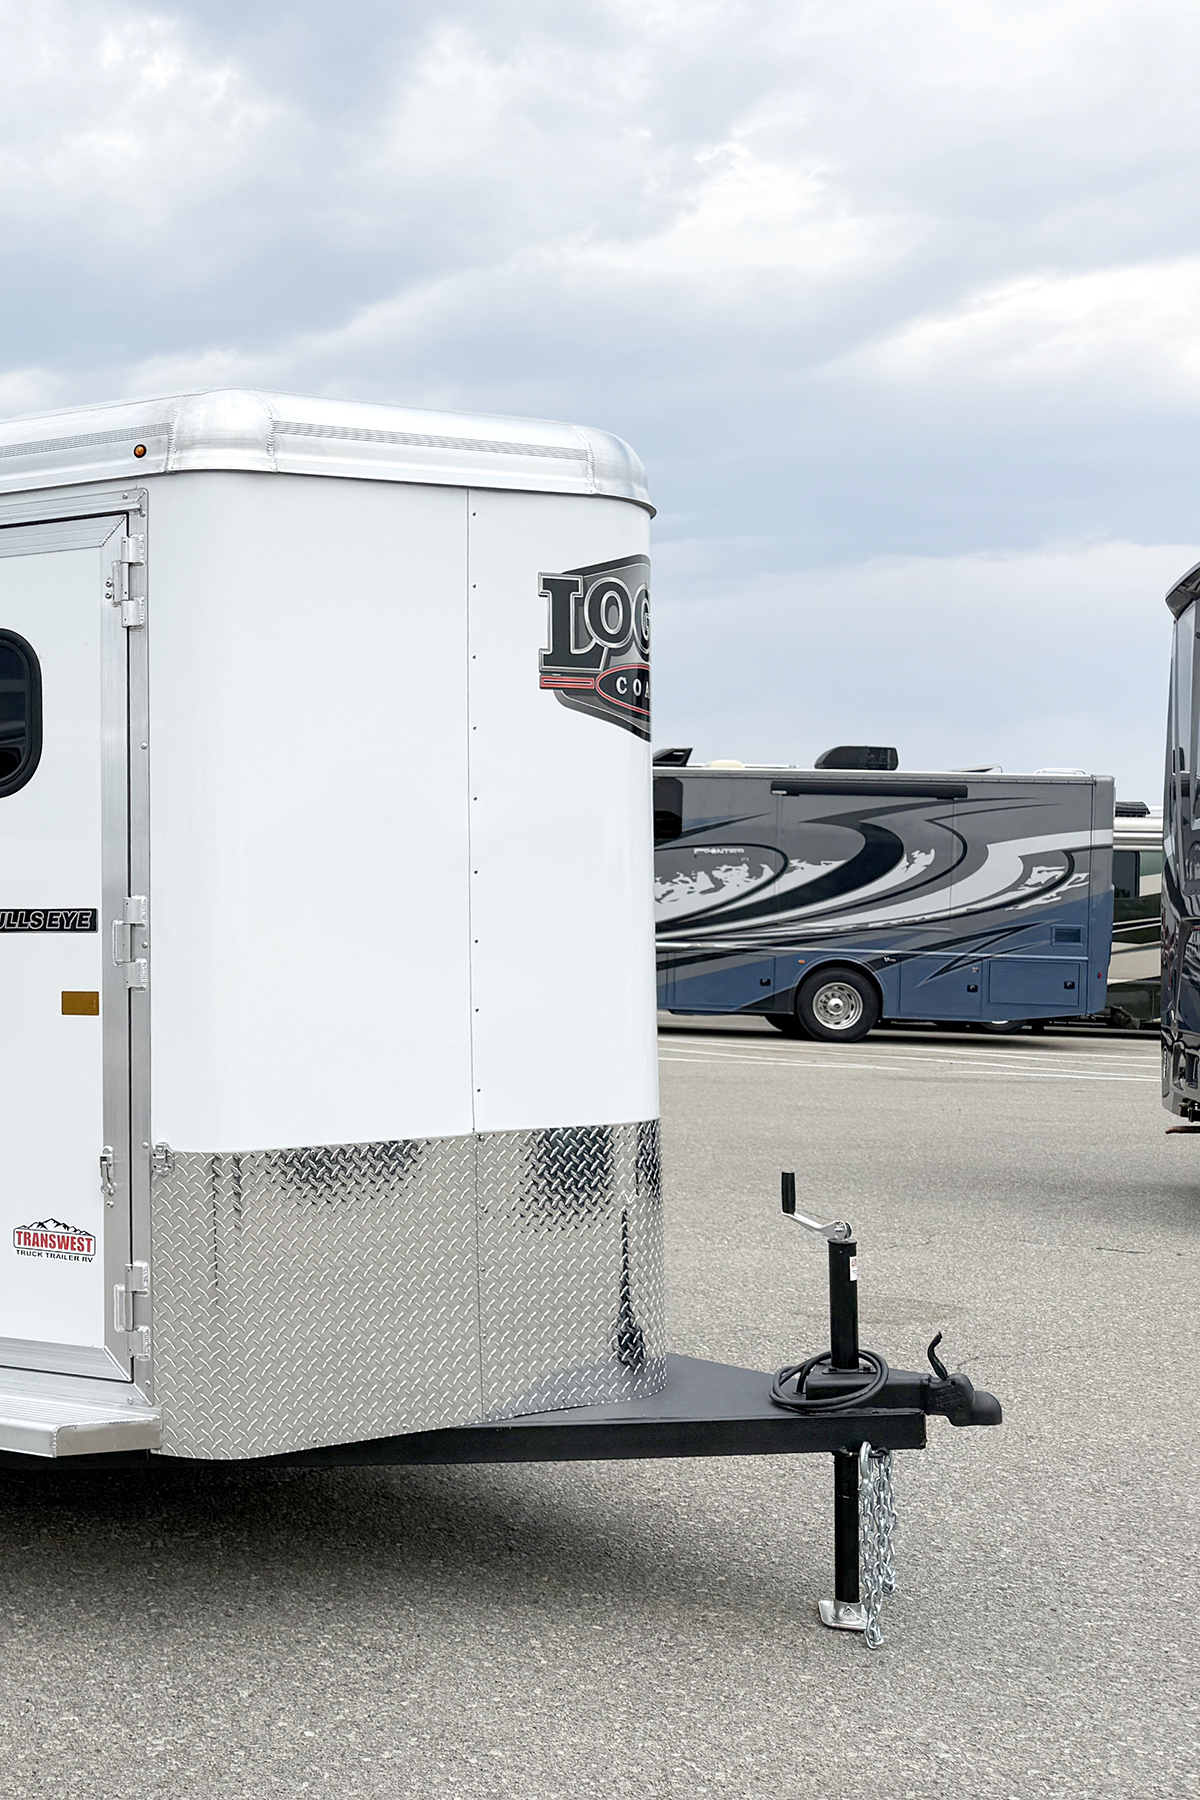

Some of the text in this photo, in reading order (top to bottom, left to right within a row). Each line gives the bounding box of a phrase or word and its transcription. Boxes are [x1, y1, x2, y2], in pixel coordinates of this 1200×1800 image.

[16, 1231, 93, 1253] TRANSWEST
[16, 1249, 43, 1258] TRUCK
[46, 1252, 80, 1262] TRAILER
